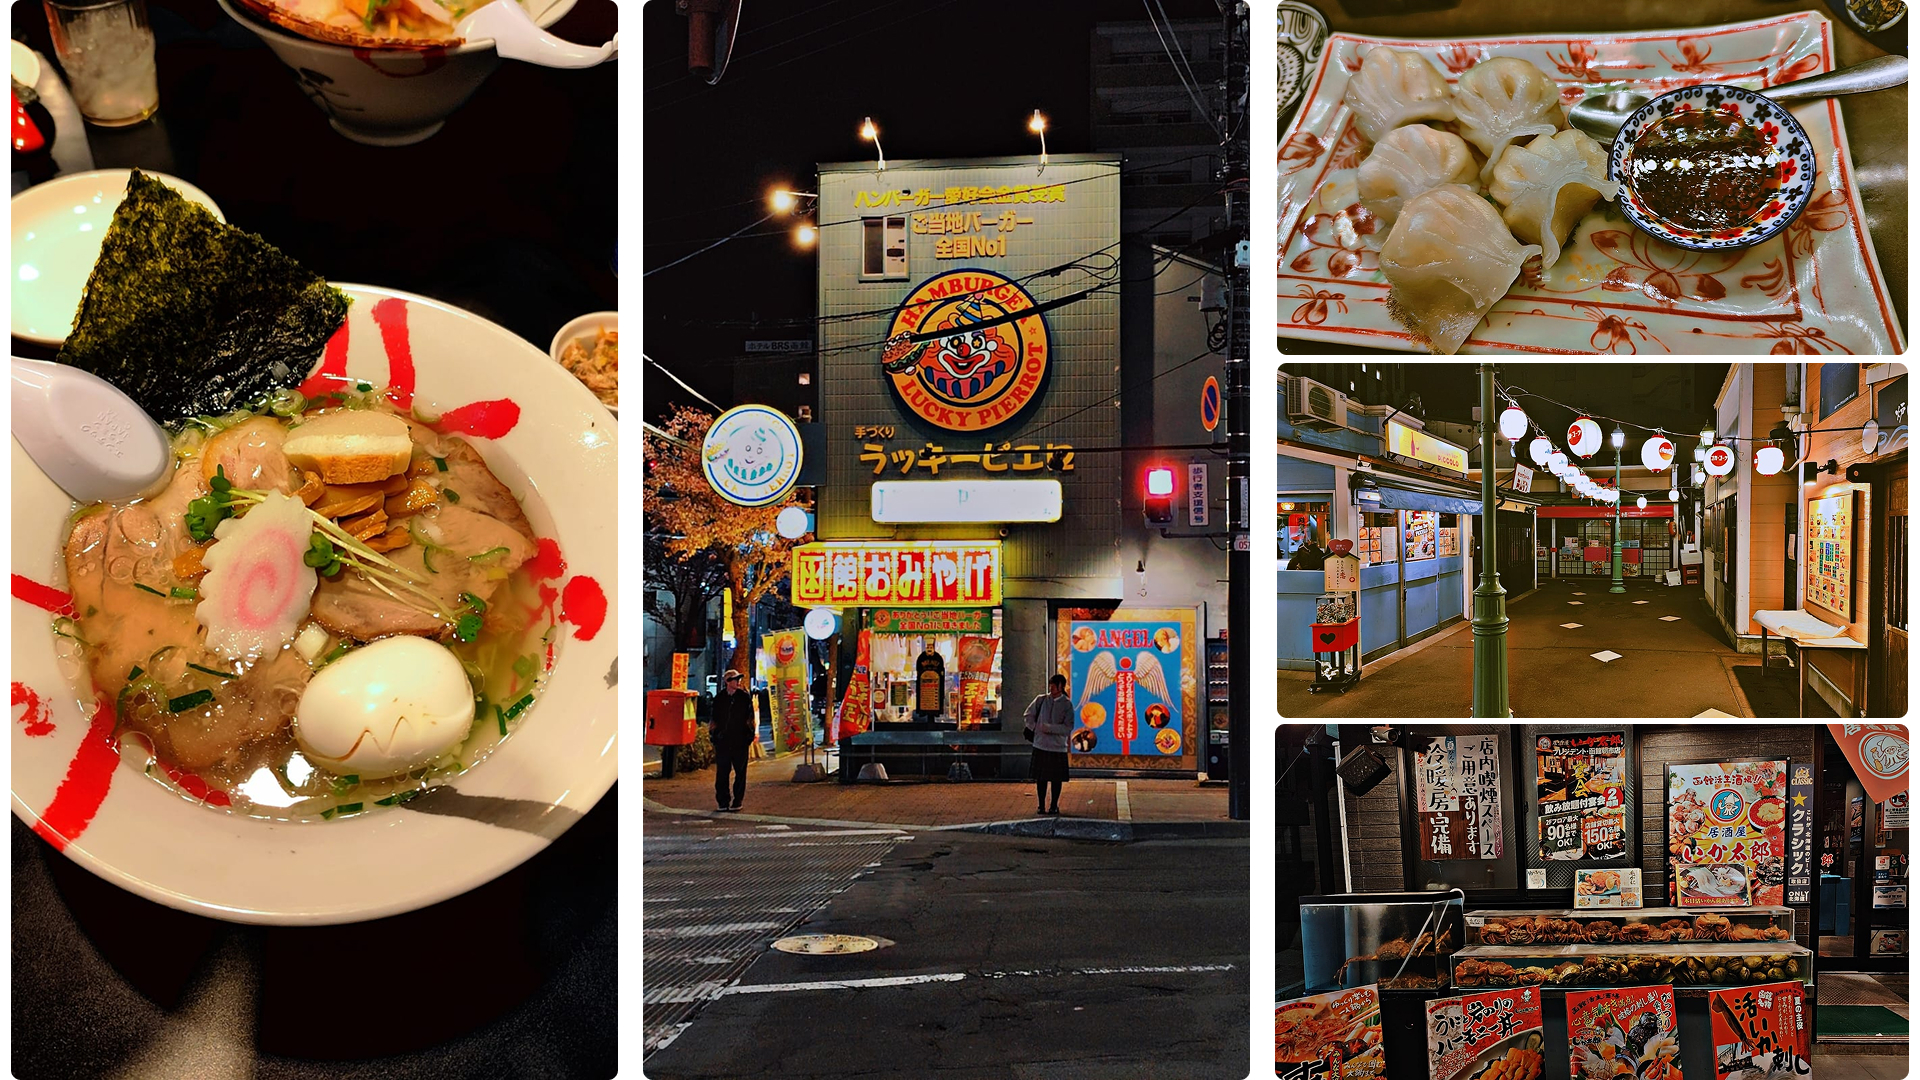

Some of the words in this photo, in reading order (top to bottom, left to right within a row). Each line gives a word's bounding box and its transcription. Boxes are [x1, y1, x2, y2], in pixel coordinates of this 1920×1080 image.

[911, 210, 1034, 235] ご当地バーガー
[935, 235, 1007, 259] 全国No1
[900, 380, 969, 427] LUCKY
[978, 342, 1043, 425] PIERROT
[854, 426, 895, 439] 手づくり
[800, 553, 990, 598] 函館おみやげ
[1097, 629, 1154, 648] ANGEL
[1790, 777, 1813, 786] CLASSIC
[1426, 743, 1452, 855] 冷暖房完備
[1461, 745, 1480, 855] ご用意あります
[1478, 737, 1497, 856] 店内喫煙スペース
[1544, 794, 1606, 814] 飲み放題付宴会
[1608, 788, 1618, 800] 2
[1547, 824, 1565, 841] 90
[1585, 827, 1608, 844] 150
[1707, 825, 1747, 838] 居酒屋
[1557, 839, 1573, 848] OK!
[1597, 842, 1613, 851] OK!
[1683, 841, 1771, 864] いか太郎
[1790, 809, 1804, 876] クラシック
